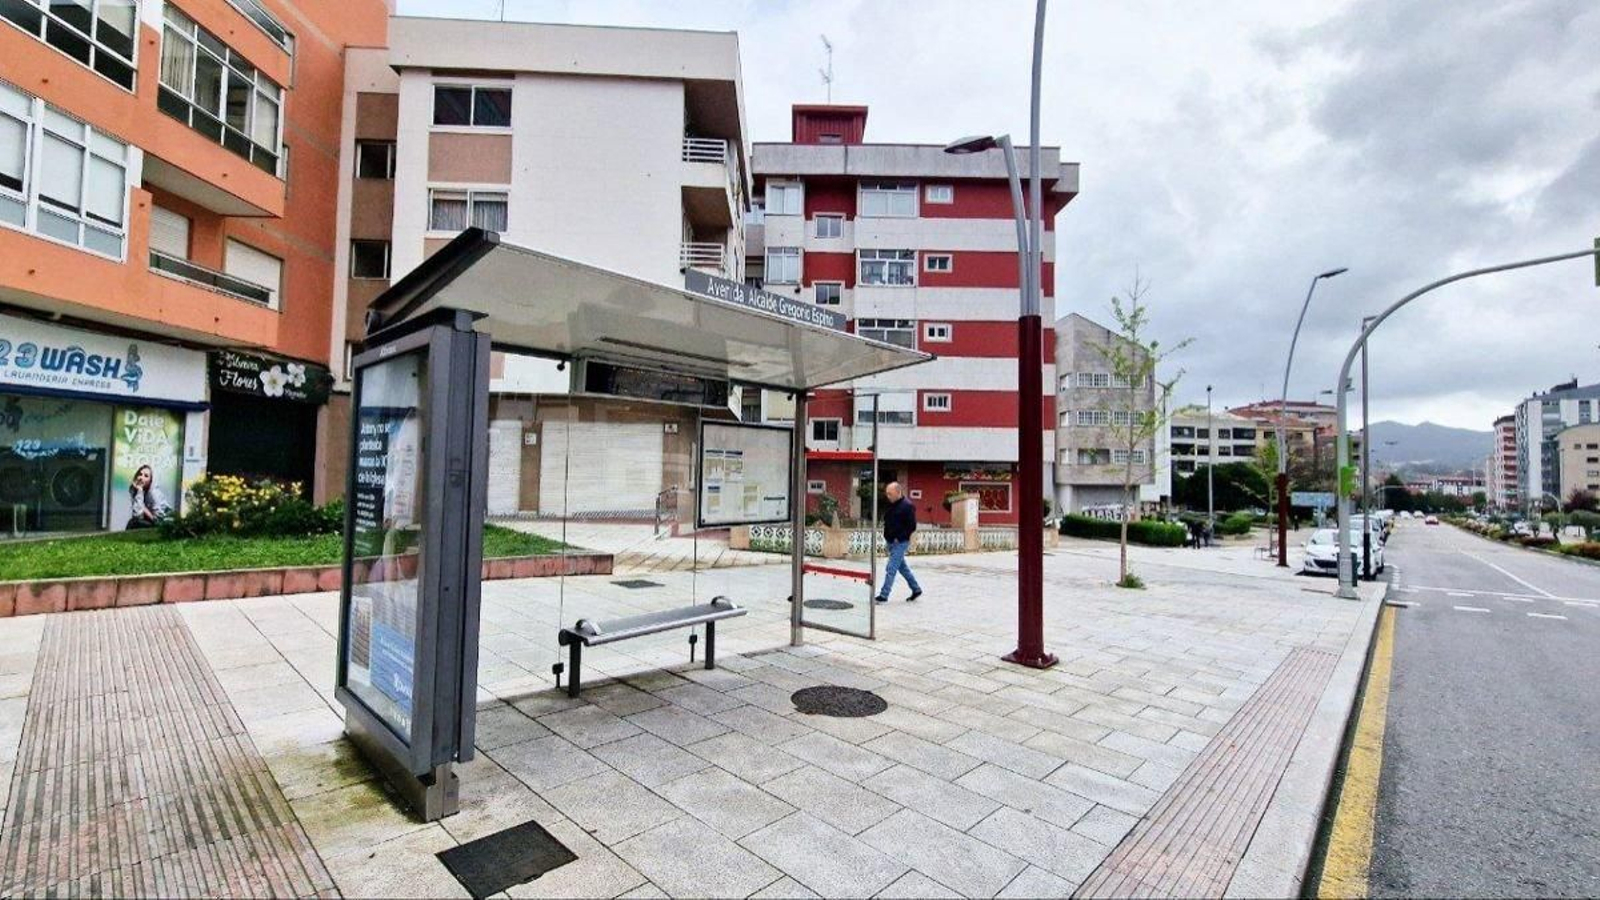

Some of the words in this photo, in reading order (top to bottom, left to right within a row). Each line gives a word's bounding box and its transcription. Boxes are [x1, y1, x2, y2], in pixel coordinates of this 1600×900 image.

[749, 289, 777, 312] Alcalde
[780, 298, 811, 320] Gregorio
[812, 307, 833, 328] Espino
[220, 369, 258, 390] Flores
